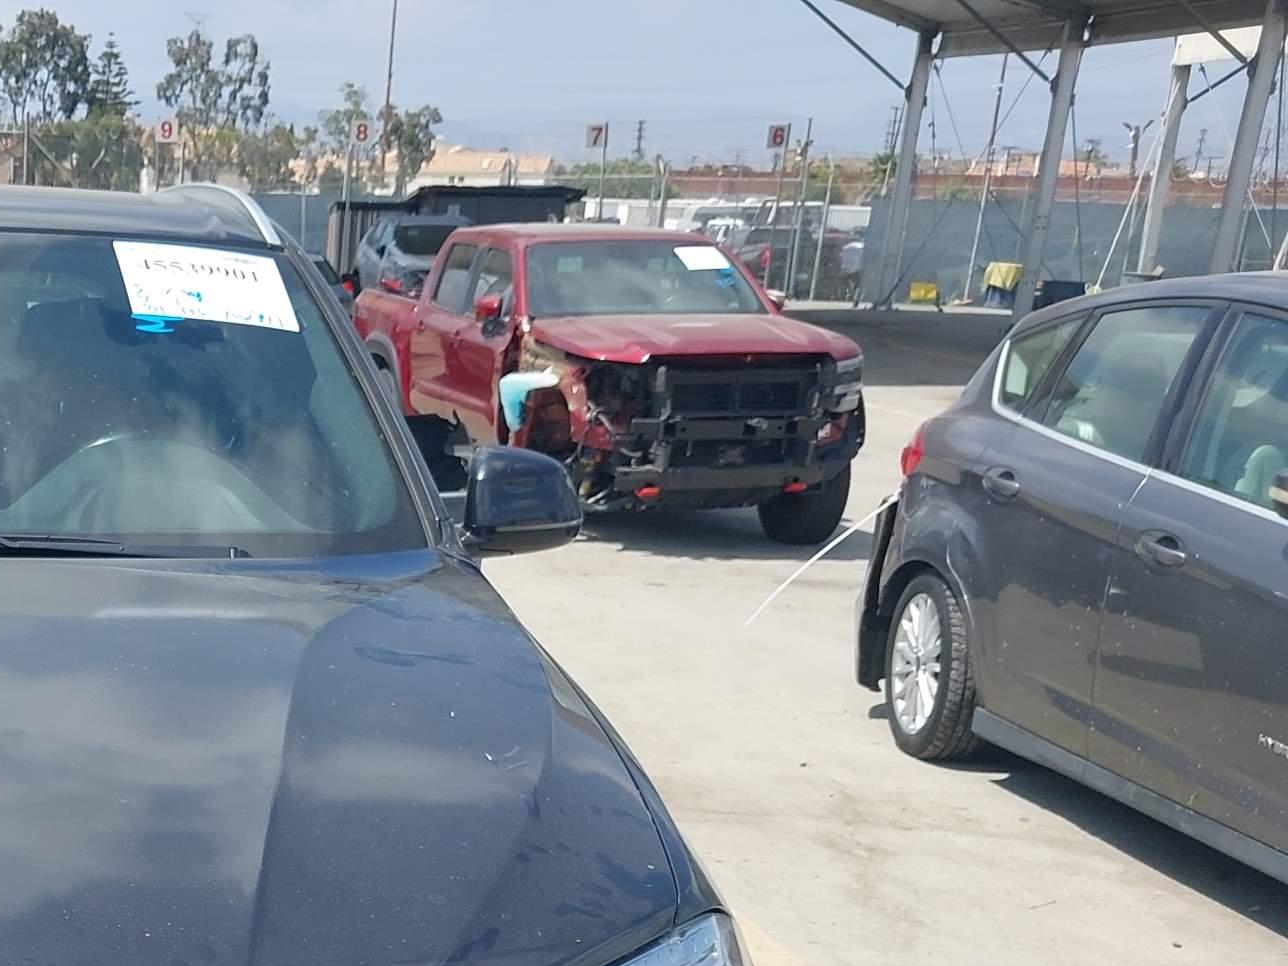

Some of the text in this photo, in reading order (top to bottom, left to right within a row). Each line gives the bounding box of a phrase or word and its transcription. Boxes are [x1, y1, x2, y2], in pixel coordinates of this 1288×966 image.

[161, 121, 173, 139] 9
[356, 123, 368, 142] 8
[591, 127, 603, 146] 7
[772, 127, 785, 146] 6
